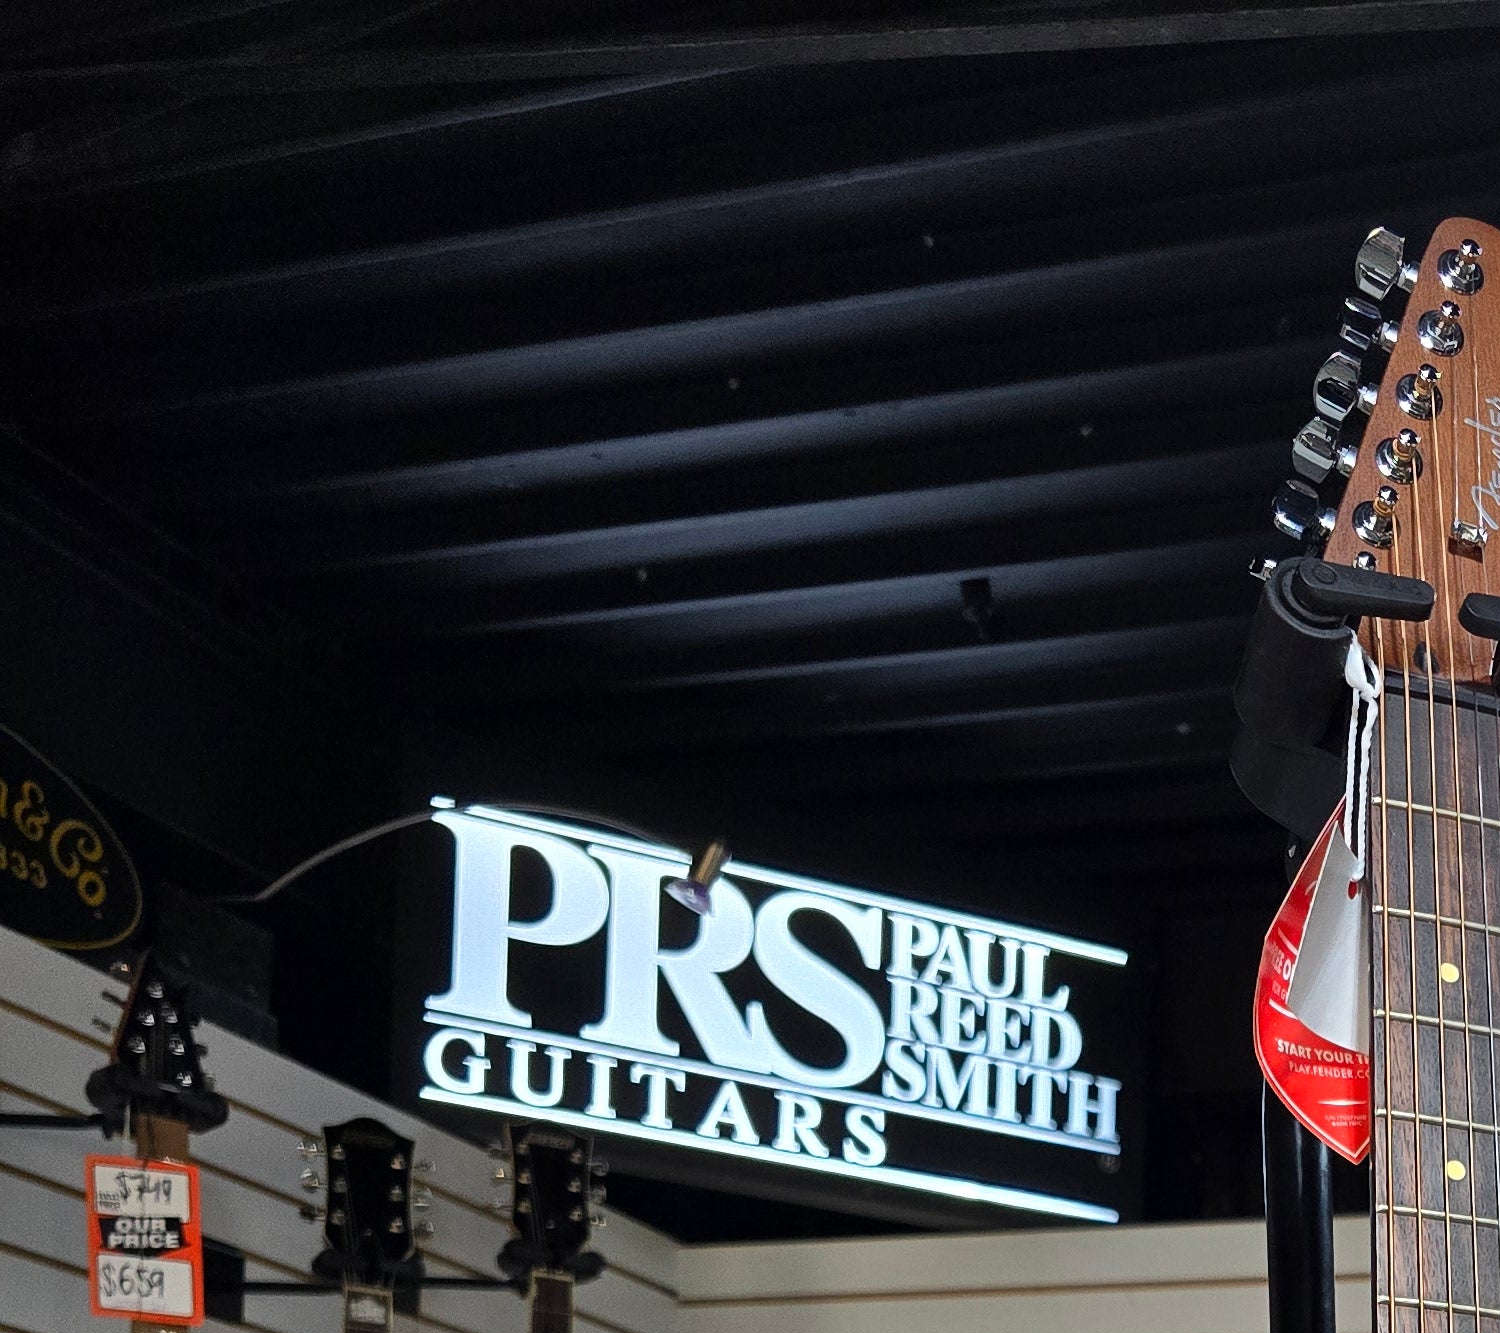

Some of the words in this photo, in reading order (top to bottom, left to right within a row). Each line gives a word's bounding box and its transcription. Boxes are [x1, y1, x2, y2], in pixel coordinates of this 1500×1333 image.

[424, 809, 886, 1088] PRS
[886, 911, 1069, 1011] PAUL
[886, 977, 1083, 1072] REED
[1313, 1048, 1354, 1065] YOUR
[422, 1028, 889, 1168] GUITARS
[881, 1039, 1123, 1146] SMITH
[107, 1232, 181, 1249] PRICE
[113, 1217, 167, 1234] OUR
